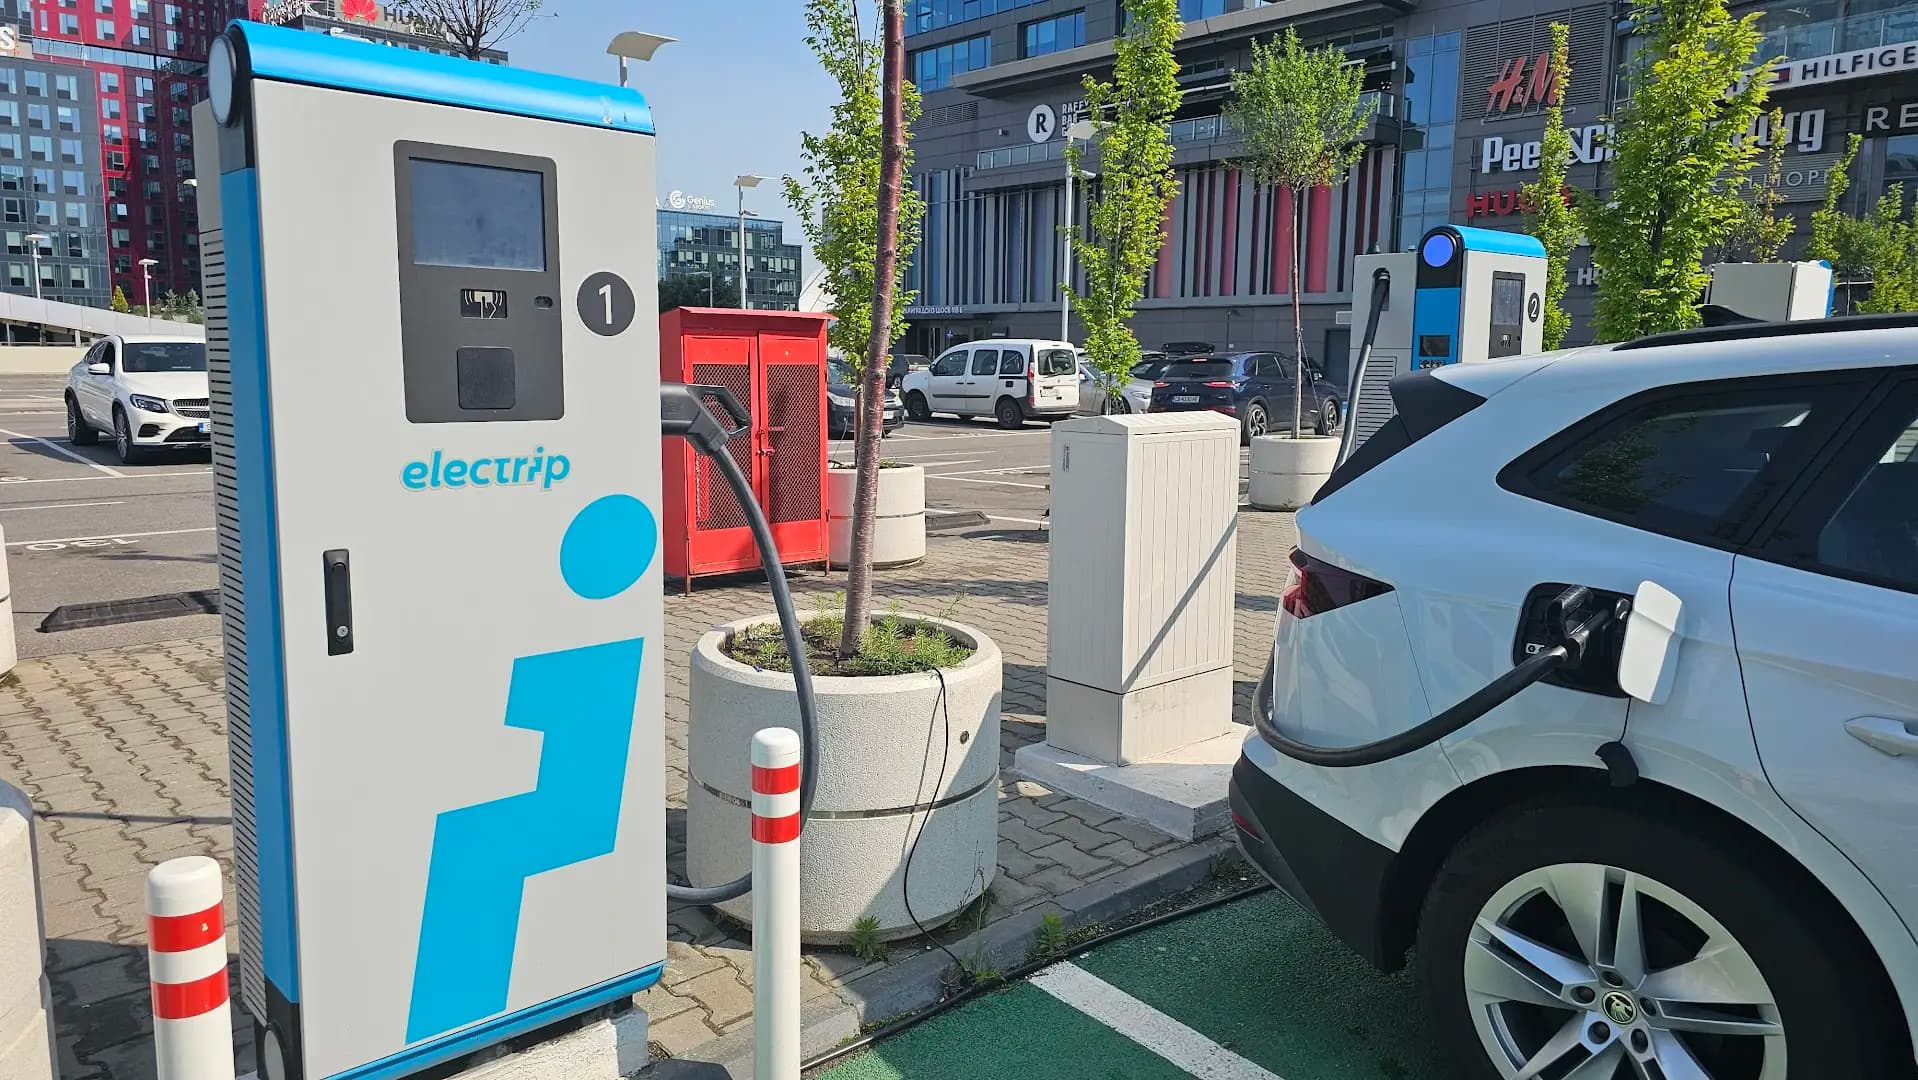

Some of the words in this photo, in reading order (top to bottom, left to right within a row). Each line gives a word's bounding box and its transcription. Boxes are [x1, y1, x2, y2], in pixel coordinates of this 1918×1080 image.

[1485, 51, 1567, 113] H&M
[1035, 113, 1048, 134] R
[1712, 170, 1831, 193] CLLIOP
[686, 195, 715, 207] Genius
[598, 283, 613, 325] 1
[1530, 298, 1538, 318] 2
[402, 446, 570, 489] electrip
